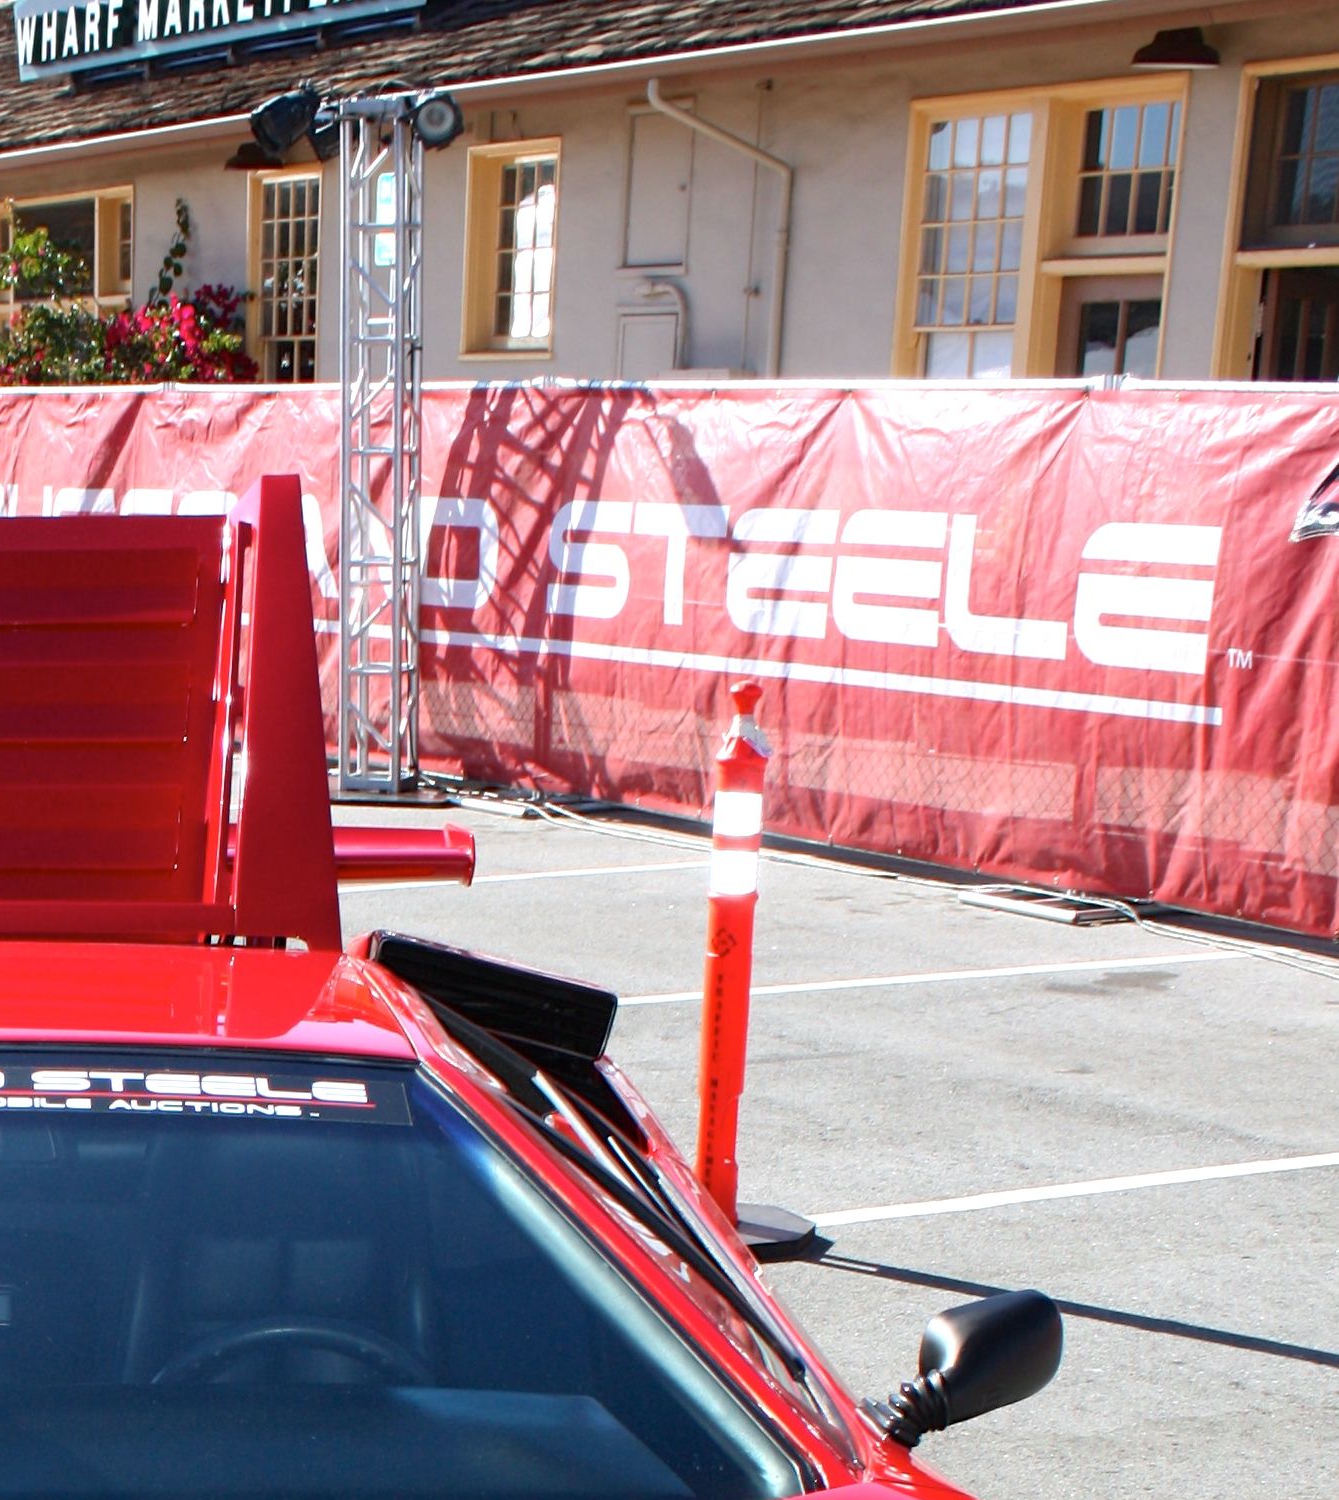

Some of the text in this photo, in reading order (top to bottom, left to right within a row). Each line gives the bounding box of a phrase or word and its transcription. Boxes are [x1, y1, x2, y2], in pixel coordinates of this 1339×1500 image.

[17, 0, 123, 65] WHARF
[546, 498, 1222, 675] STEELE
[31, 1070, 368, 1103] STEELE
[108, 1100, 302, 1117] AUCTIONS
